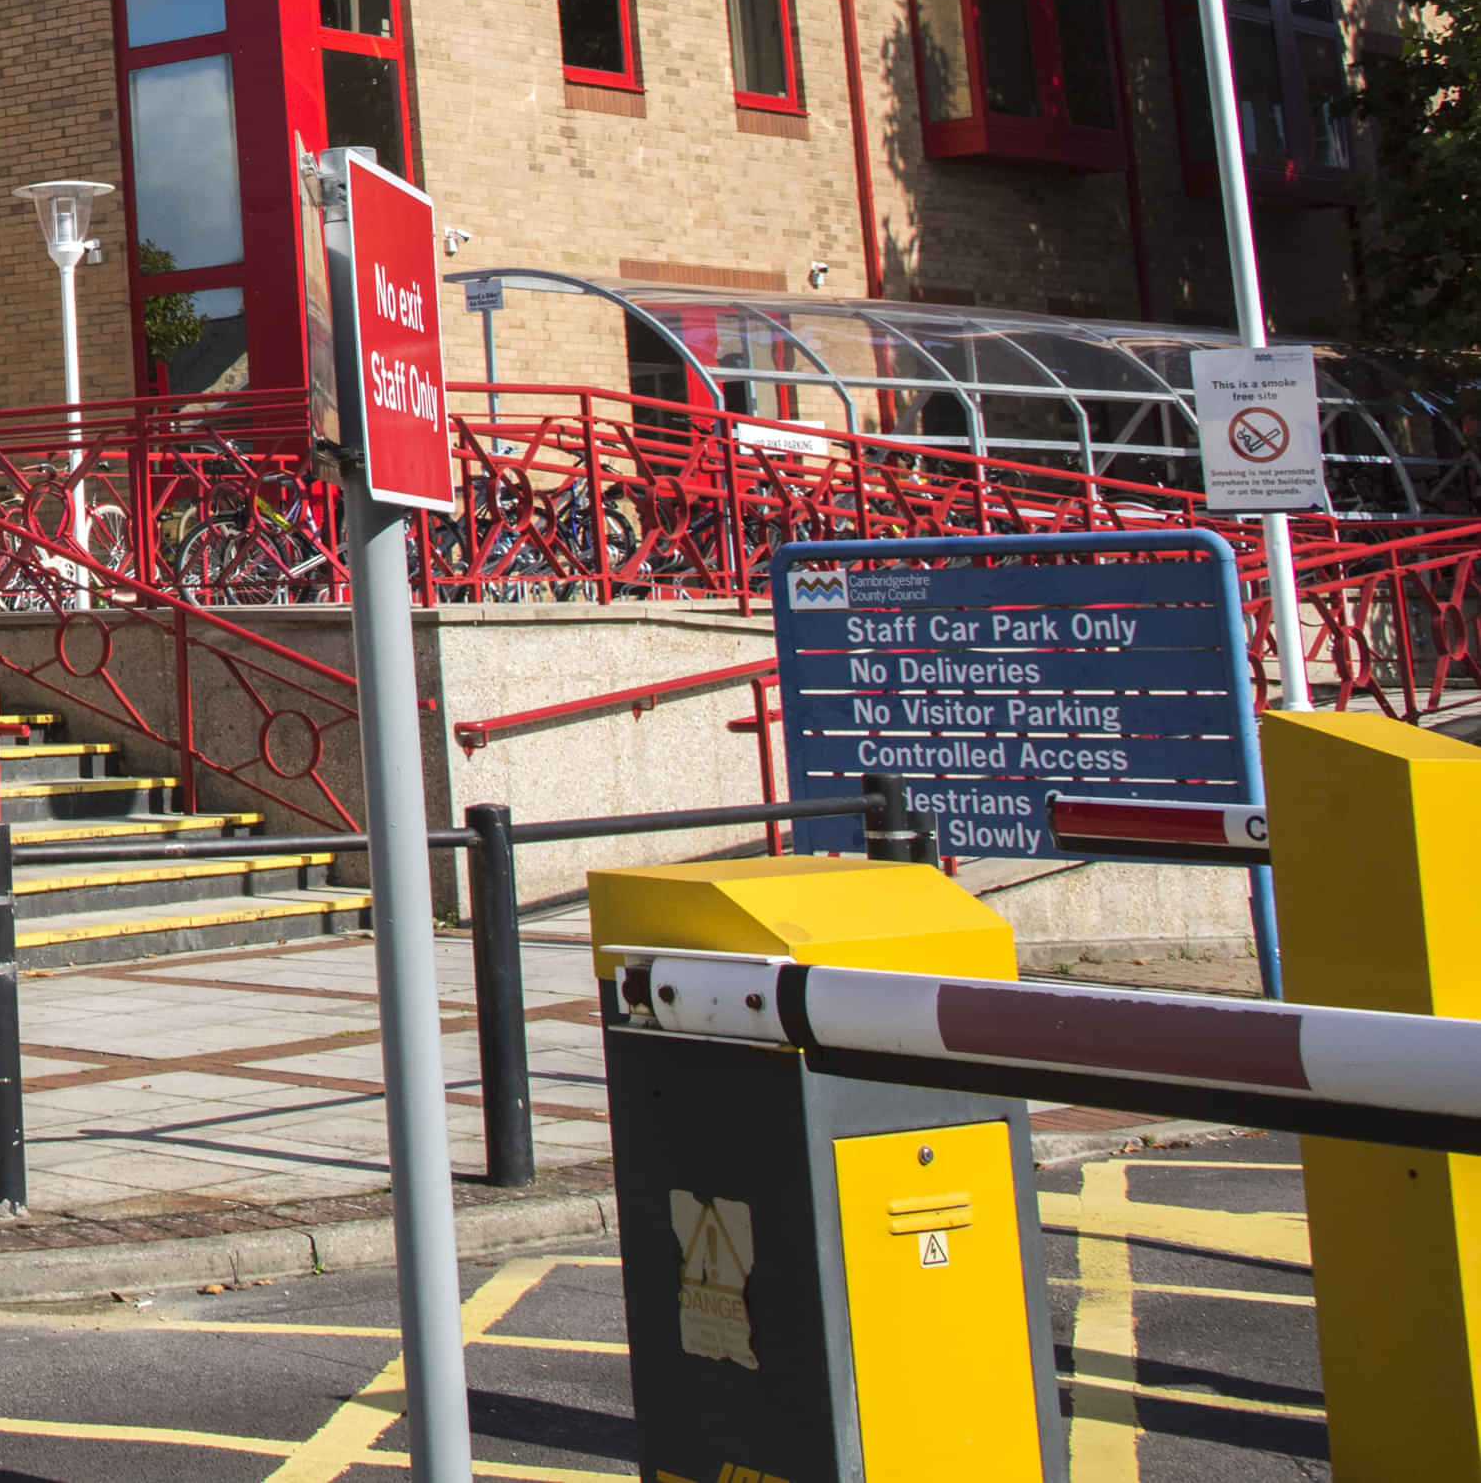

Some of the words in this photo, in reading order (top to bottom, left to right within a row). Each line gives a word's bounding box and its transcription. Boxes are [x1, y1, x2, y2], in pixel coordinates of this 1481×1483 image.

[374, 262, 397, 322] No
[399, 281, 425, 333] exit
[371, 350, 407, 413] Staff
[409, 365, 439, 433] Only
[1211, 380, 1235, 390] This
[1238, 380, 1248, 389] is
[1261, 378, 1297, 388] smoke
[1232, 392, 1254, 401] free
[1257, 392, 1278, 401] site
[1211, 469, 1246, 478] Smoking
[1274, 468, 1316, 477] permitted
[1212, 479, 1250, 487] anywhere
[1262, 478, 1276, 486] the
[1277, 478, 1317, 486] buildings
[1250, 488, 1263, 496] the
[848, 574, 930, 589] Cambridgeshire
[849, 589, 887, 603] County
[888, 589, 928, 601] Council
[847, 615, 917, 643] Staff
[929, 615, 980, 643] Car
[992, 614, 1060, 641] Park
[1071, 613, 1137, 646] Only
[849, 657, 887, 684] No
[899, 657, 1041, 684] Deliveries
[852, 698, 891, 725] No
[901, 698, 995, 726] Visitor
[1007, 699, 1122, 732] Parking
[857, 740, 1006, 769] Controlled
[1019, 742, 1128, 771] Access
[948, 819, 1042, 855] Slowly
[679, 1291, 744, 1322] DANGE
